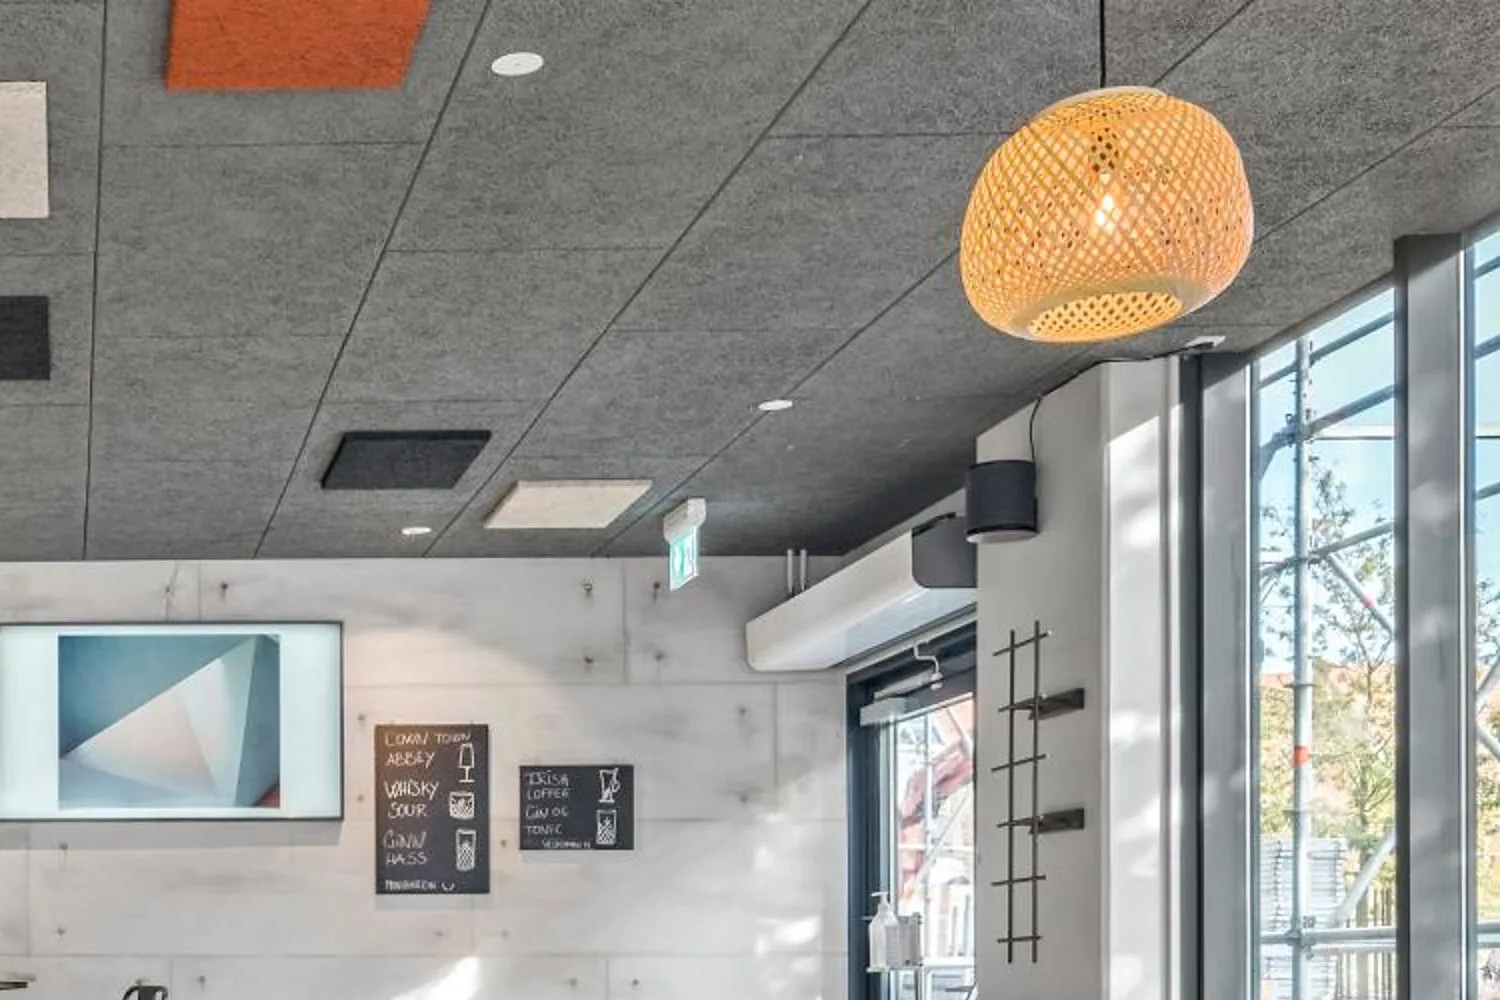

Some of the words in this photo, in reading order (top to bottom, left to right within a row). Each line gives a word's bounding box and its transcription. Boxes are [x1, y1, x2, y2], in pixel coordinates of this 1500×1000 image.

[385, 750, 435, 768] ABBEY
[384, 778, 440, 800] WHISKY
[388, 801, 427, 819] SOUR
